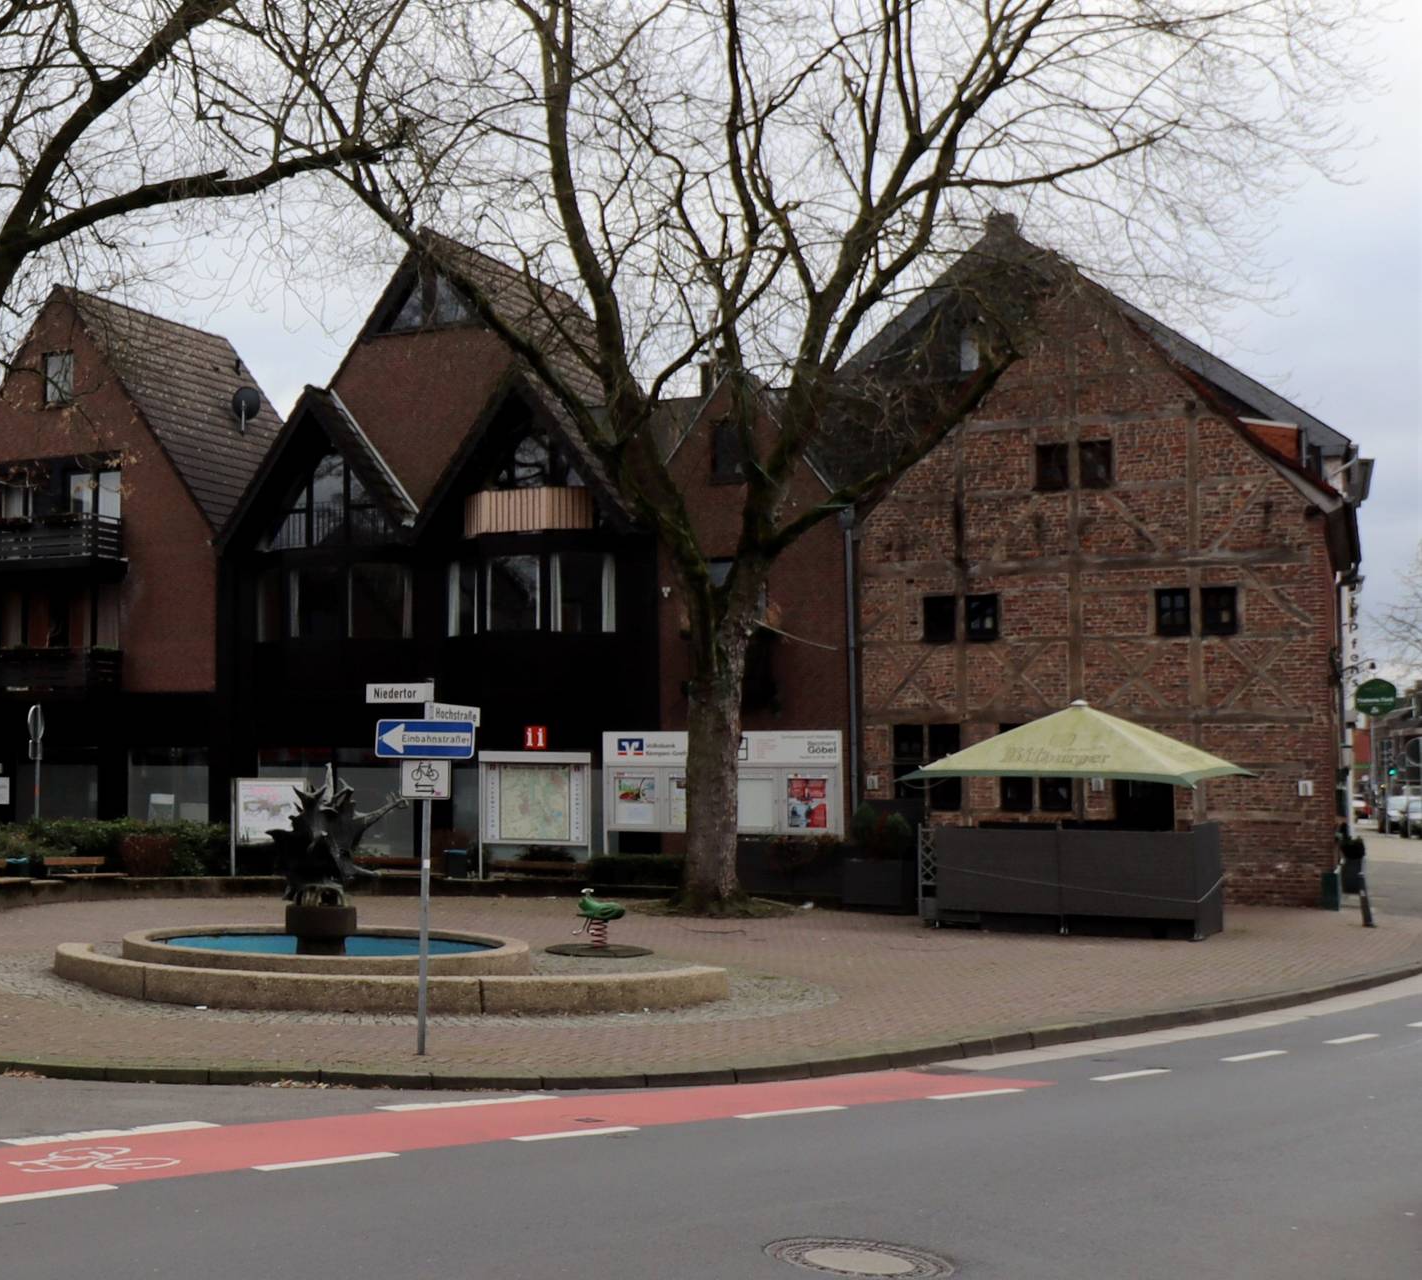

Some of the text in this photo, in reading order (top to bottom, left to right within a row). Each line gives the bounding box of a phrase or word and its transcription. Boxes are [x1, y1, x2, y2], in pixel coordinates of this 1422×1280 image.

[373, 687, 417, 699] Niedertor
[435, 706, 477, 722] Hochstraße
[401, 733, 467, 745] Einbahnstraße
